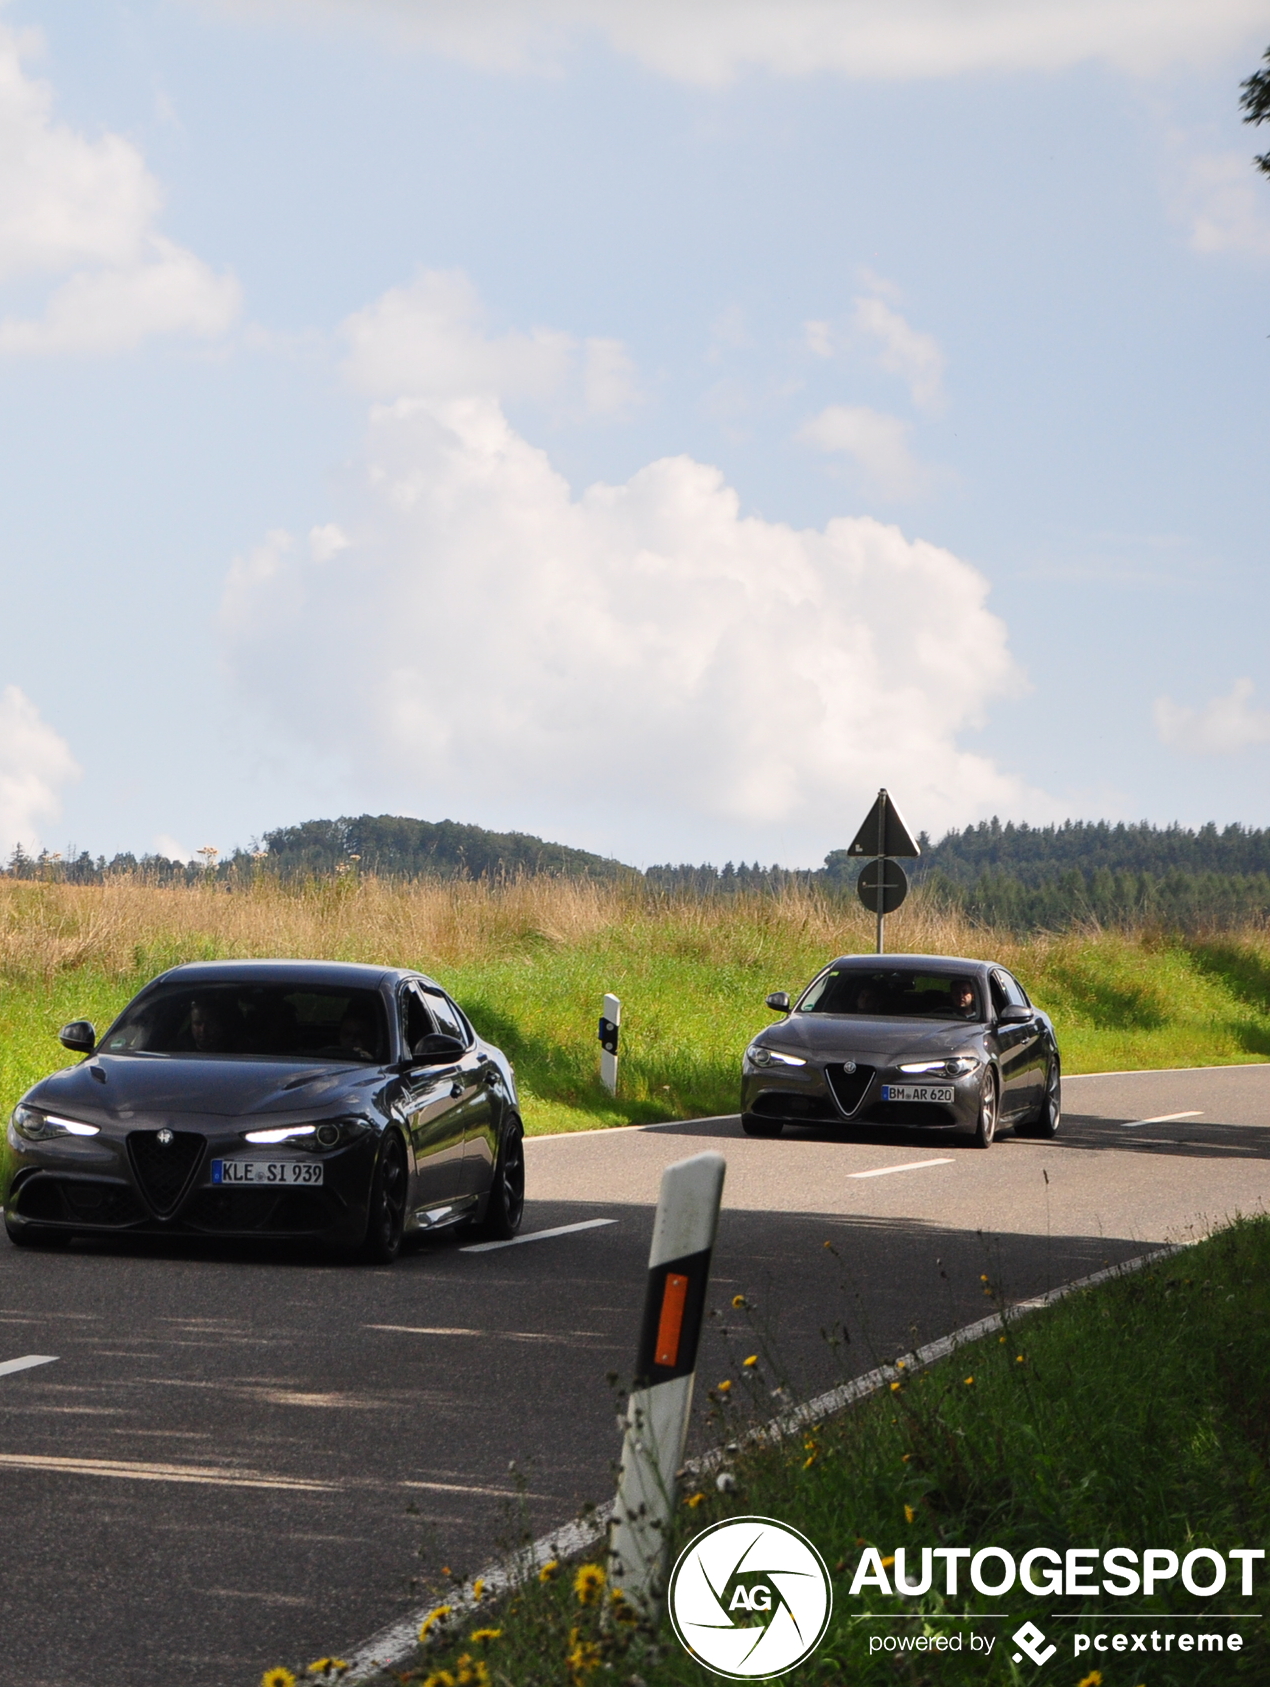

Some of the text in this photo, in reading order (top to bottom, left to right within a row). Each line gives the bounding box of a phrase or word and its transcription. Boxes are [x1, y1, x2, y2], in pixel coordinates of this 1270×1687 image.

[889, 1087, 905, 1099] BM
[912, 1088, 927, 1100] AR
[930, 1089, 951, 1101] 620
[223, 1163, 322, 1183] KLE SI 939
